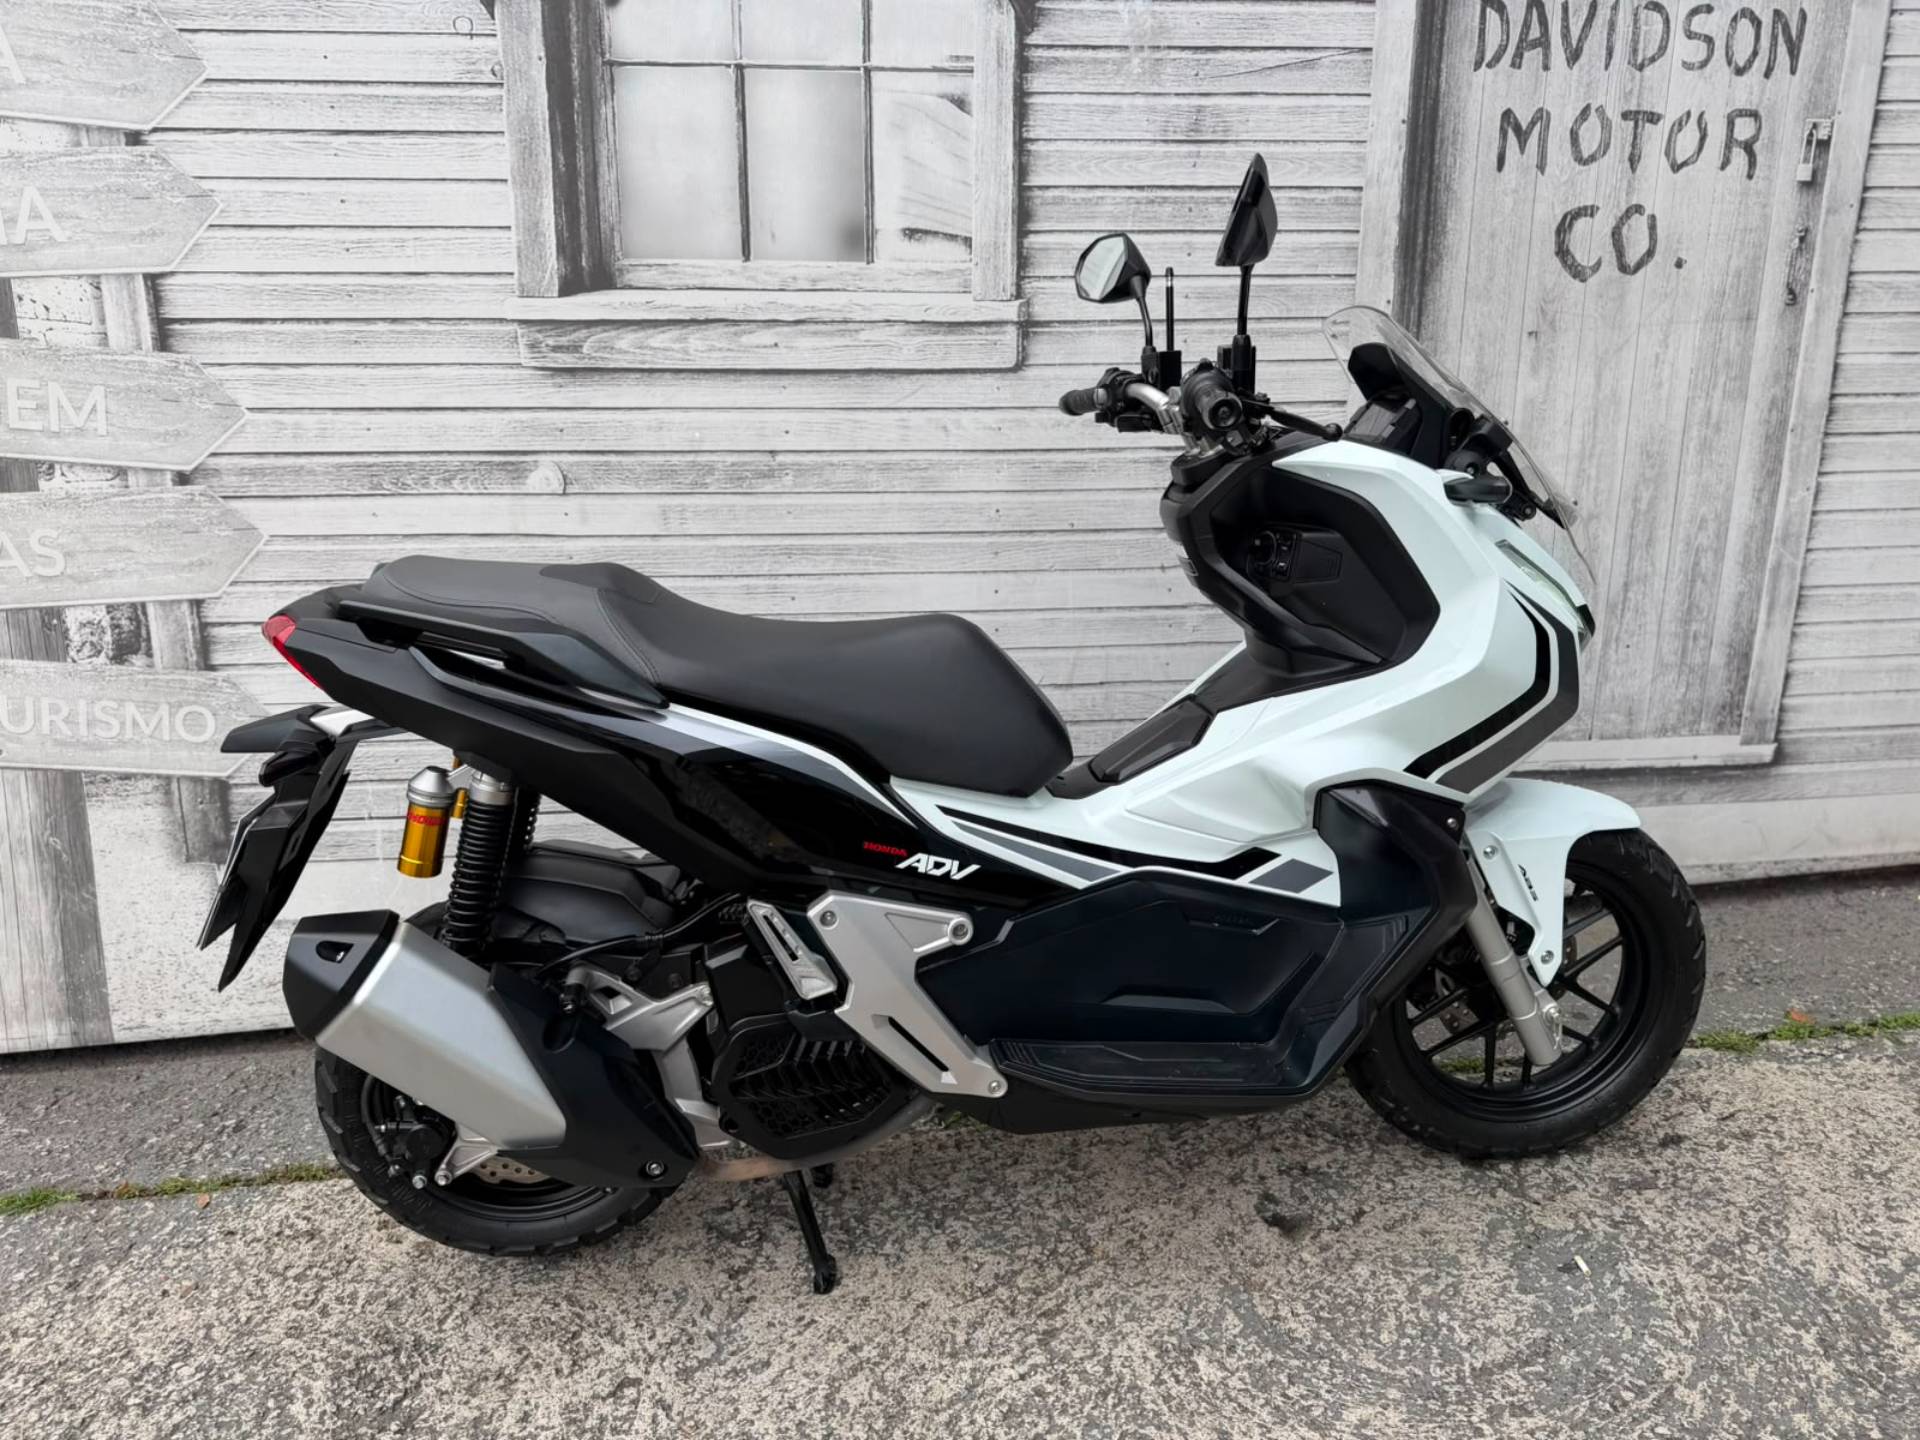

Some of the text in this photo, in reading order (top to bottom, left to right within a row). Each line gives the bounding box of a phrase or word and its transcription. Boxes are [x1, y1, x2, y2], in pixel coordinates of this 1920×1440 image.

[1473, 0, 1807, 79] DAVIDSON
[1496, 103, 1762, 181] MOTOR
[1554, 203, 1687, 283] CO.
[863, 841, 908, 858] HONDA
[894, 852, 981, 880] ADV
